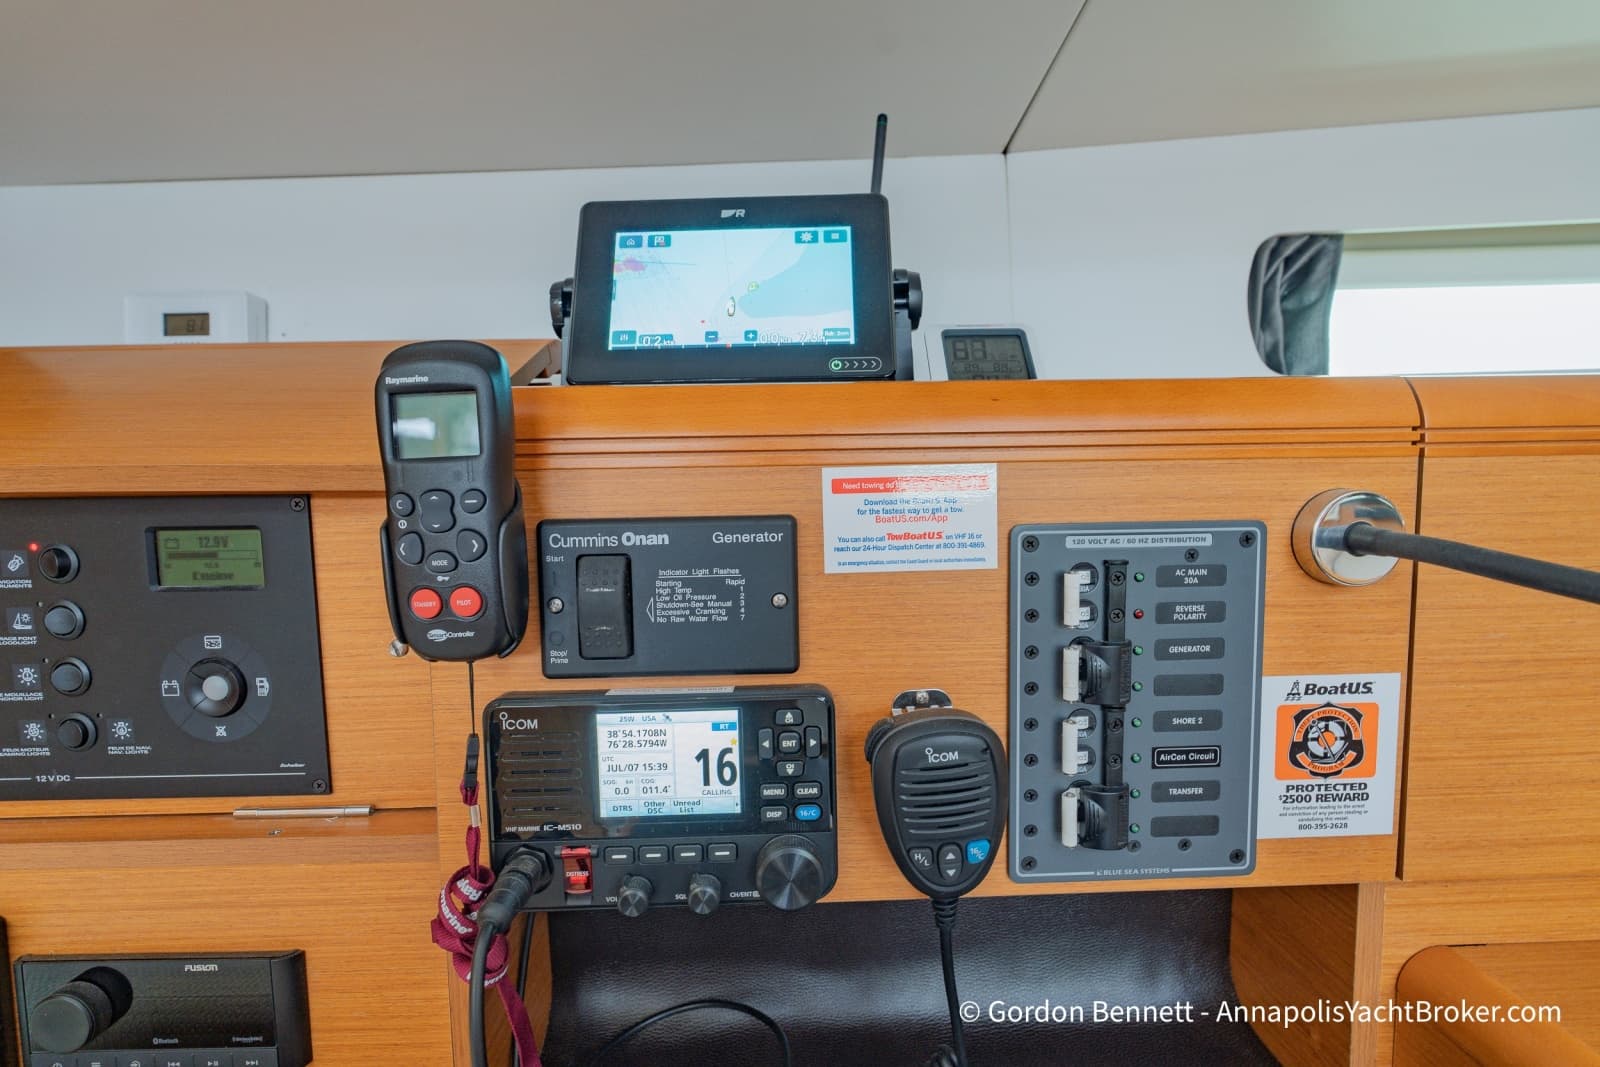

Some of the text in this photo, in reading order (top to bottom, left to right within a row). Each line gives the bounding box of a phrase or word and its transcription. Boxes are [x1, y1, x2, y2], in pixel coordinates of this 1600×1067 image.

[385, 374, 429, 385] Raymarine
[843, 482, 860, 490] Need
[862, 481, 884, 490] towing
[864, 498, 898, 506] Download
[857, 508, 867, 516] for
[882, 507, 905, 515] fastest
[907, 508, 921, 516] way
[931, 506, 942, 515] get
[875, 514, 948, 524] BoatUS.com/App
[549, 531, 783, 549] Cummins Onan Generator
[1087, 537, 1108, 545] VOLT
[1151, 535, 1207, 544] DISTRIBUTION
[888, 544, 913, 552] Dispatch
[691, 568, 710, 577] Light
[713, 567, 740, 575] Flashes
[1175, 568, 1208, 577] AC MAIN
[656, 578, 746, 588] Starting Rapid
[656, 588, 671, 596] High
[674, 586, 692, 594] Temp
[673, 593, 682, 601] Oil
[685, 593, 717, 601] Pressure
[740, 592, 745, 600] 2
[656, 599, 745, 609] Shutdown-See Manual 3
[656, 606, 745, 616] Excessive Cranking 4
[1175, 605, 1205, 613] REVERSE
[670, 615, 686, 623] Raw
[688, 614, 708, 622] Water
[711, 614, 729, 622] Flow
[1173, 612, 1207, 621] POLARITY
[550, 649, 568, 658] Stop/
[1168, 644, 1211, 654] GENERATOR
[550, 656, 569, 664] Prime
[1171, 717, 1197, 726] SHORE
[782, 740, 797, 748] ENT
[1159, 752, 1215, 762] AirCon Circuit
[607, 762, 668, 773] JUL/07 15:39
[694, 747, 738, 787] 16
[1307, 760, 1345, 771] PROGRAM
[614, 786, 630, 796] 0.0
[763, 788, 785, 796] MENU
[796, 787, 818, 795] CLEAR
[1168, 787, 1204, 796] TRANSFER
[1285, 782, 1368, 793] PROTECTED
[701, 789, 732, 797] CALLING
[1278, 792, 1370, 804] $2500 REWARD
[643, 800, 666, 808] Other
[673, 799, 701, 808] Unread
[612, 805, 633, 813] DTRS
[647, 807, 663, 815] DSC
[679, 806, 694, 814] List
[800, 809, 817, 817] 16/C
[766, 810, 783, 819] DISP
[543, 823, 582, 832] IC-M510
[1298, 822, 1348, 831] 800-395-2628
[1140, 867, 1170, 875] SYSTEMS
[184, 964, 219, 972] FUSION
